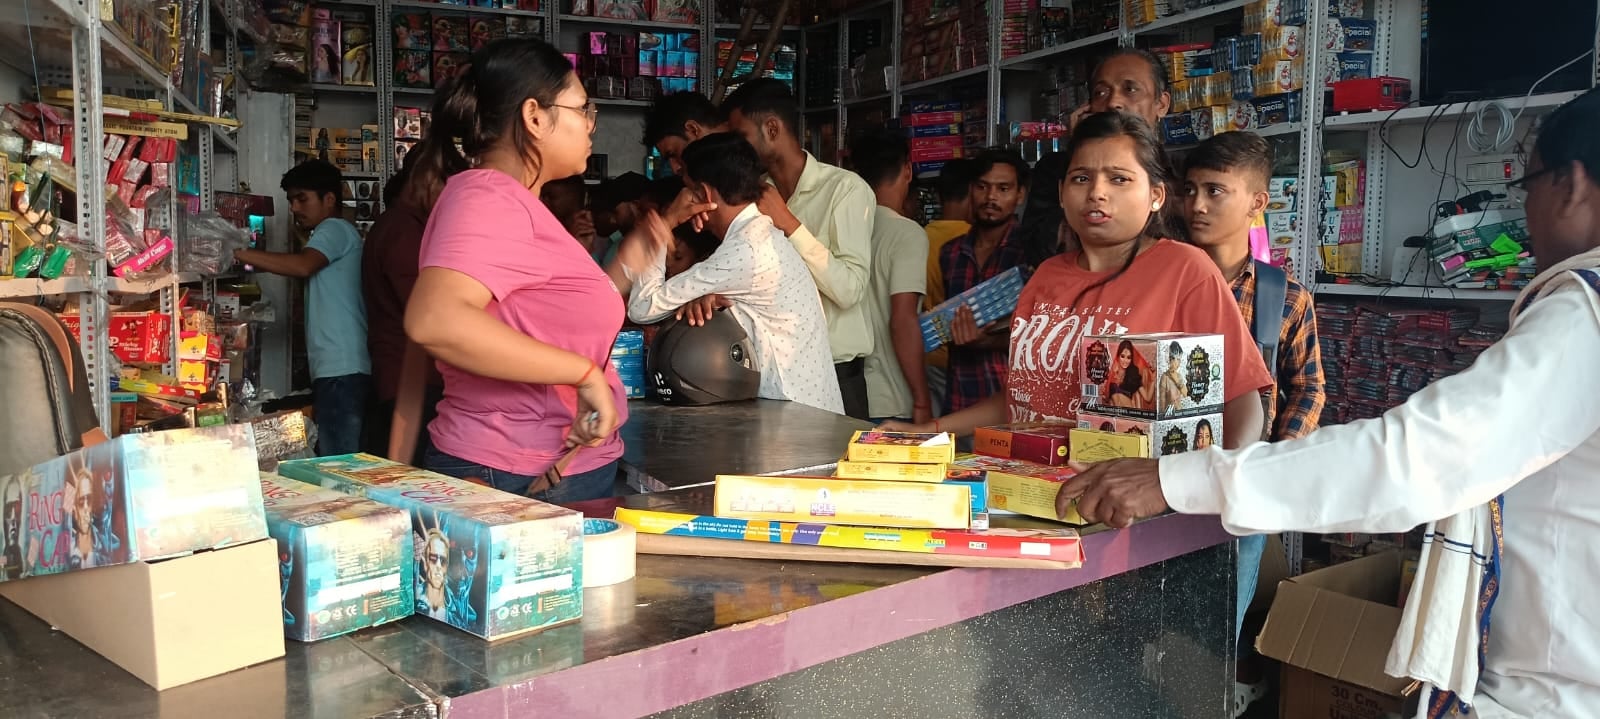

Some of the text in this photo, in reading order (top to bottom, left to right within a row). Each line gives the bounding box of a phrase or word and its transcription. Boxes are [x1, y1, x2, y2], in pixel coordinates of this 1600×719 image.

[29, 491, 63, 530] RING
[39, 529, 71, 568] CAP
[1331, 685, 1349, 699] 30
